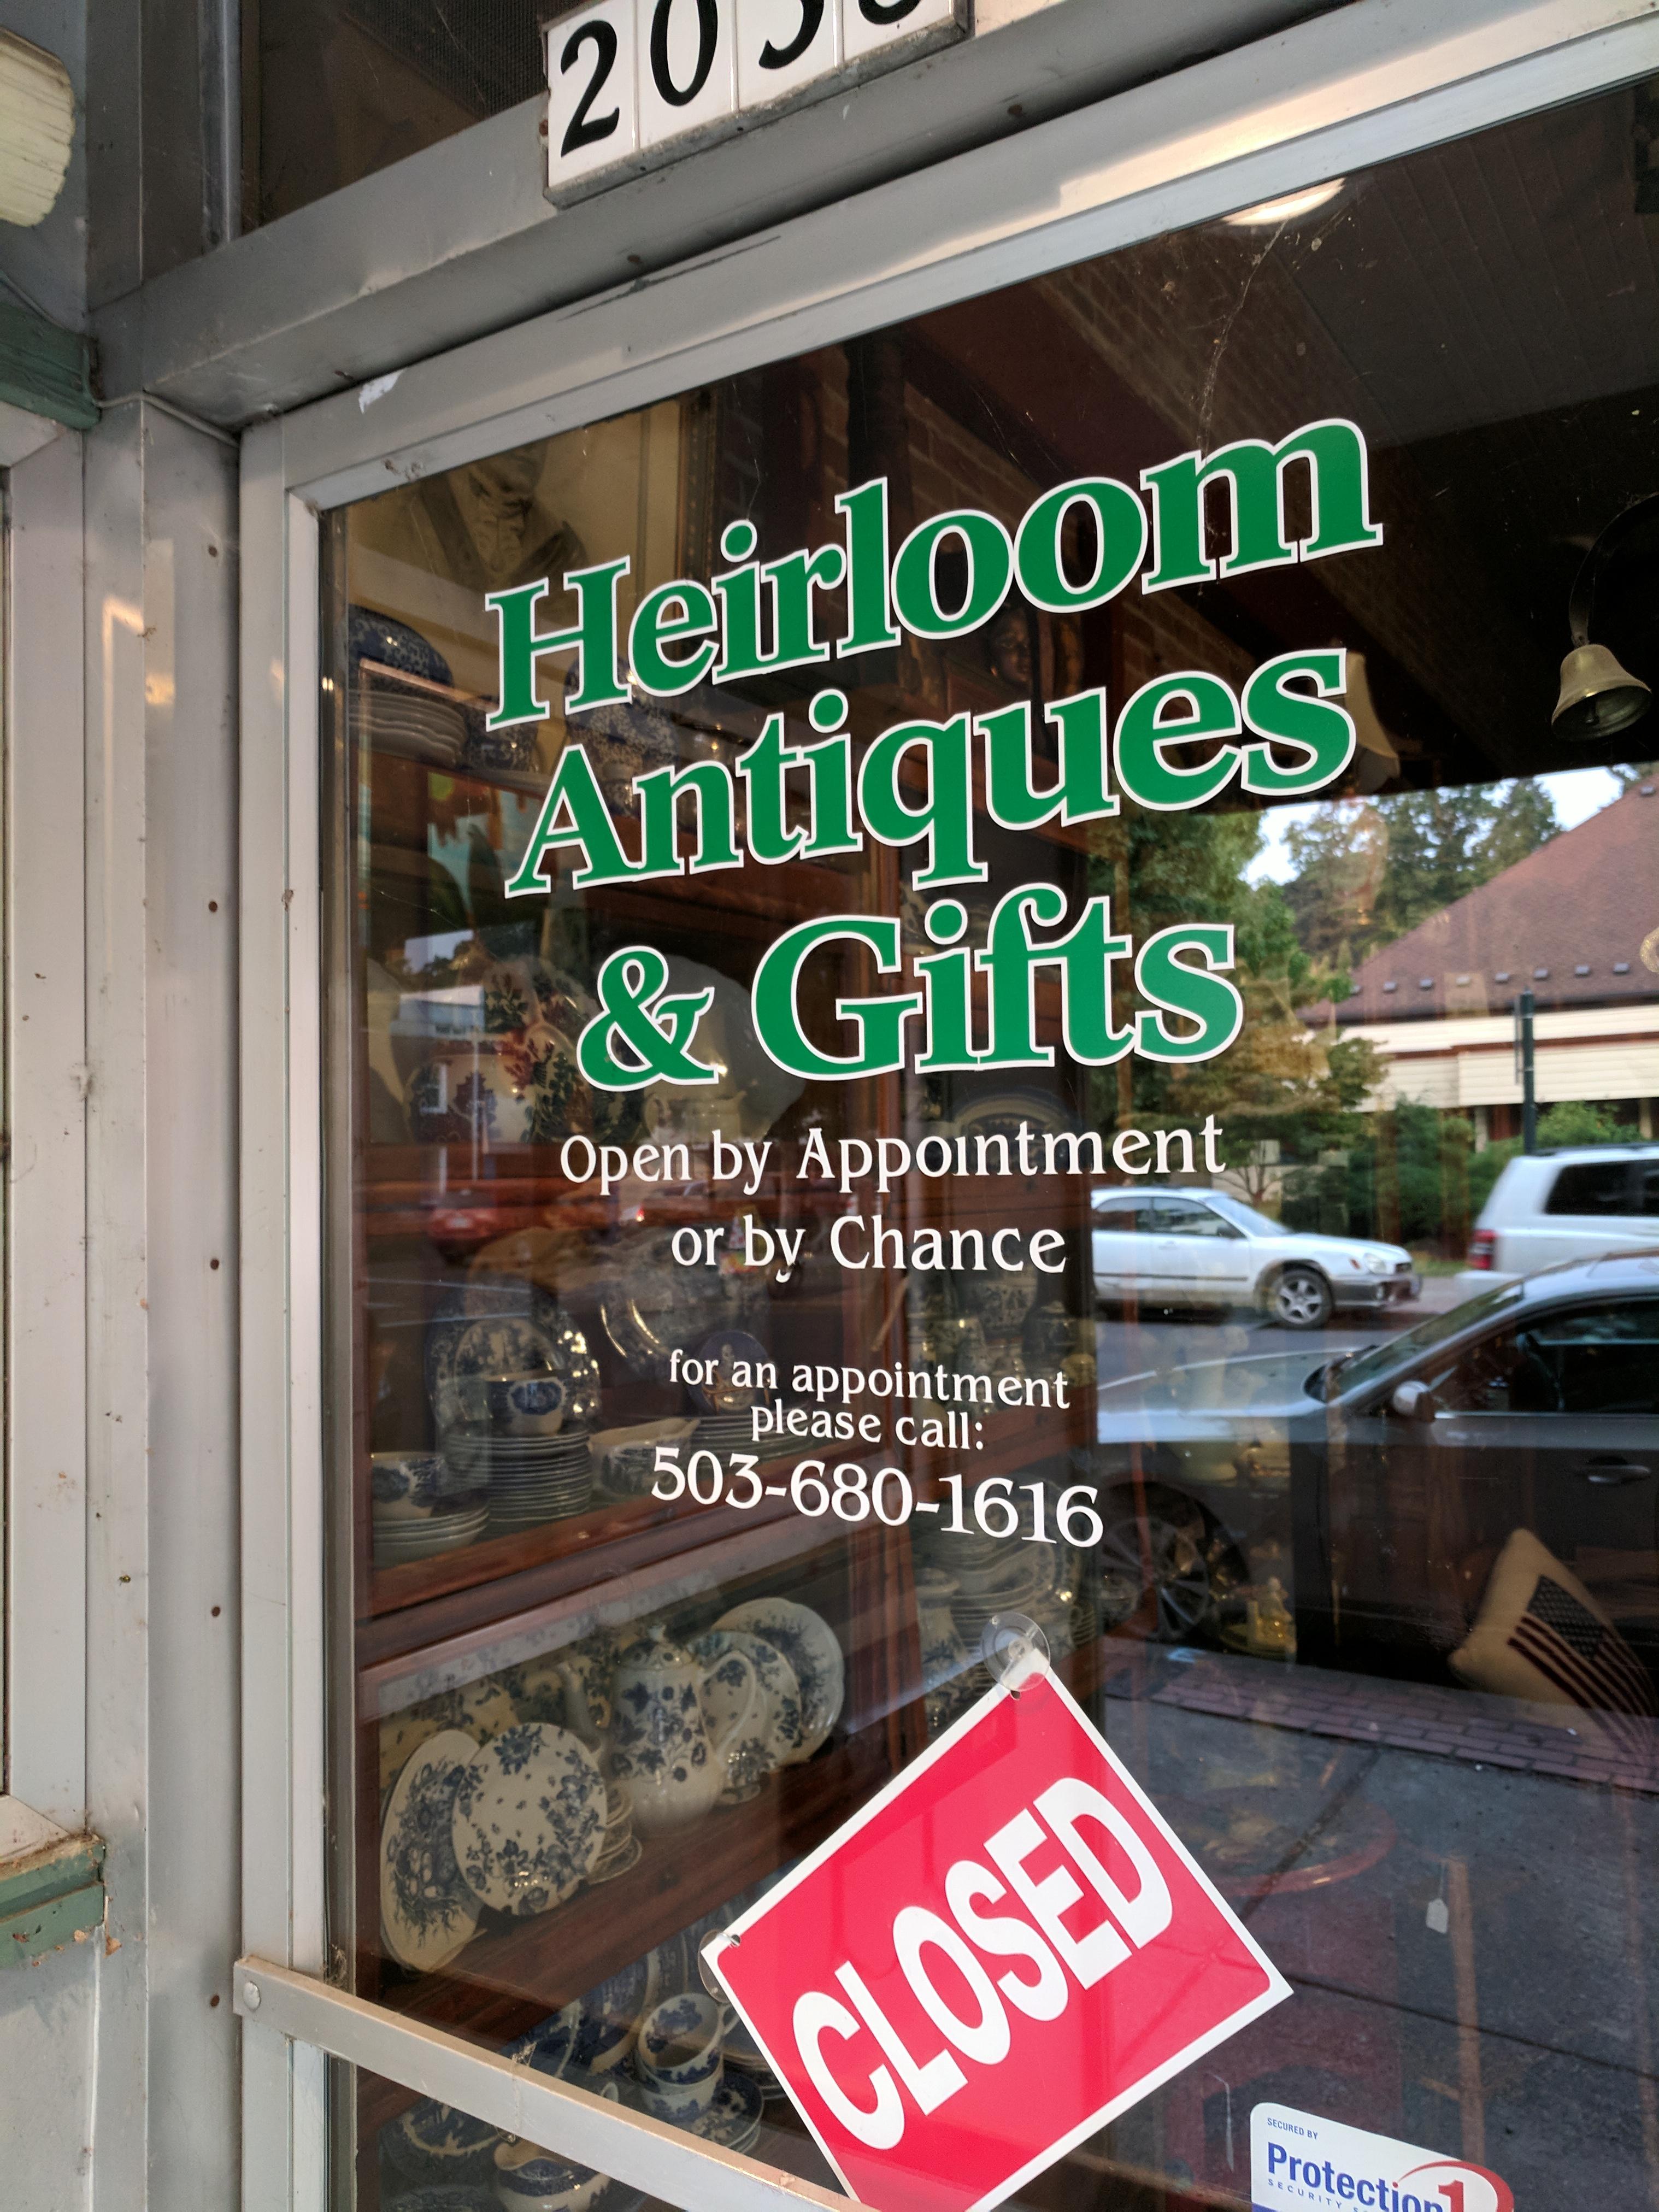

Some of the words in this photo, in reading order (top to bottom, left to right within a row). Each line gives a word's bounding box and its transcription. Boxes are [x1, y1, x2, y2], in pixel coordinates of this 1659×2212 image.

[485, 417, 1384, 732] Heirloom
[504, 648, 1357, 899] Antiques
[576, 945, 720, 1092] &
[751, 883, 1245, 1082] Gifts
[560, 1135, 690, 1196] Open
[713, 1129, 772, 1196] by
[796, 1114, 1226, 1193] Appointment
[671, 1226, 724, 1267] or
[743, 1214, 807, 1283] by
[830, 1215, 1067, 1274] Chance
[669, 1350, 718, 1386] for
[732, 1359, 777, 1389] an
[791, 1362, 1070, 1409] appointment
[751, 1399, 882, 1443] please
[895, 1408, 984, 1450] call:
[651, 1446, 1104, 1548] 503-680-1616
[792, 1777, 1173, 2150] CLOSED
[1267, 2117, 1305, 2135] SECURED
[1307, 2130, 1318, 2140] BY
[1268, 2178, 1343, 2210] SECURITY
